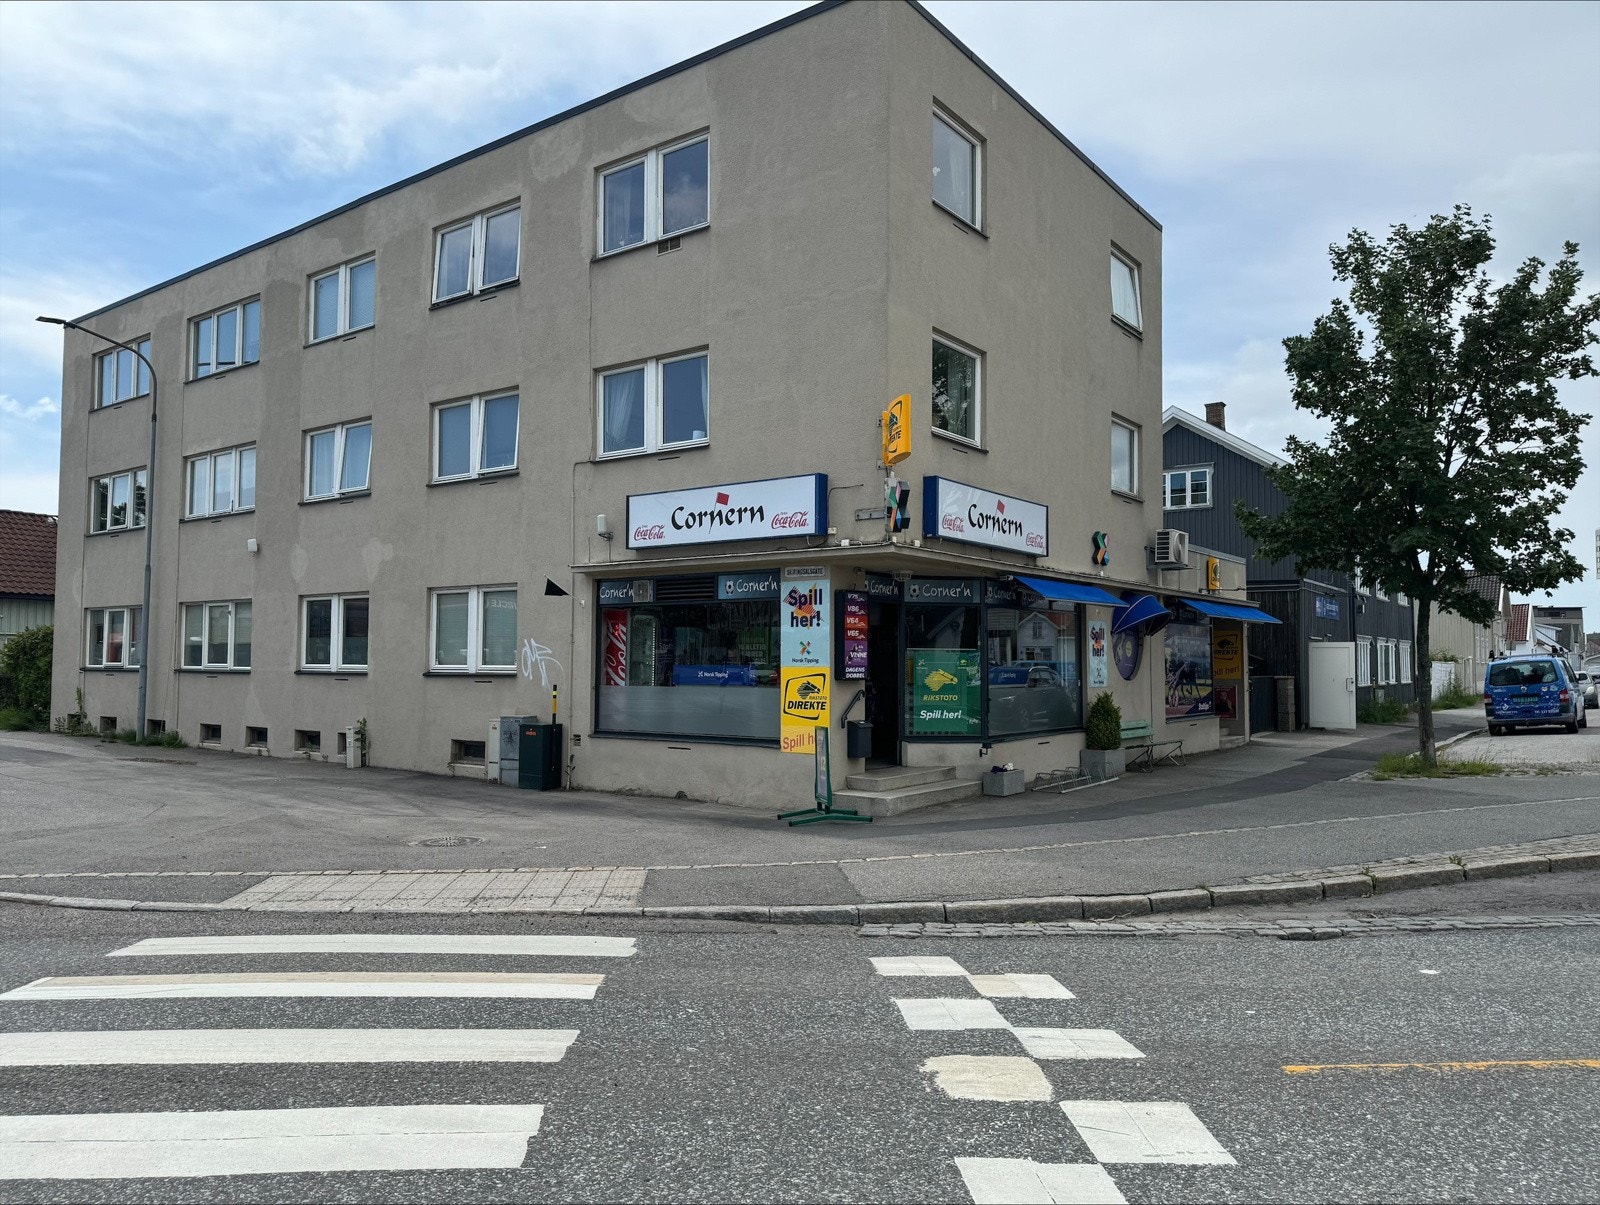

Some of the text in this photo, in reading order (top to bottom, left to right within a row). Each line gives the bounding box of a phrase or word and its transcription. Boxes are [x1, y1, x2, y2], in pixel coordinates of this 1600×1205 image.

[671, 504, 765, 531] Cornern
[968, 504, 1023, 537] Cornern
[736, 576, 778, 592] Corner'n
[922, 583, 972, 597] Corner'n
[788, 588, 823, 610] Spill
[790, 610, 821, 628] her!
[787, 700, 827, 711] DIREKTE
[920, 710, 962, 720] Spill her!
[783, 733, 805, 751] Spill
